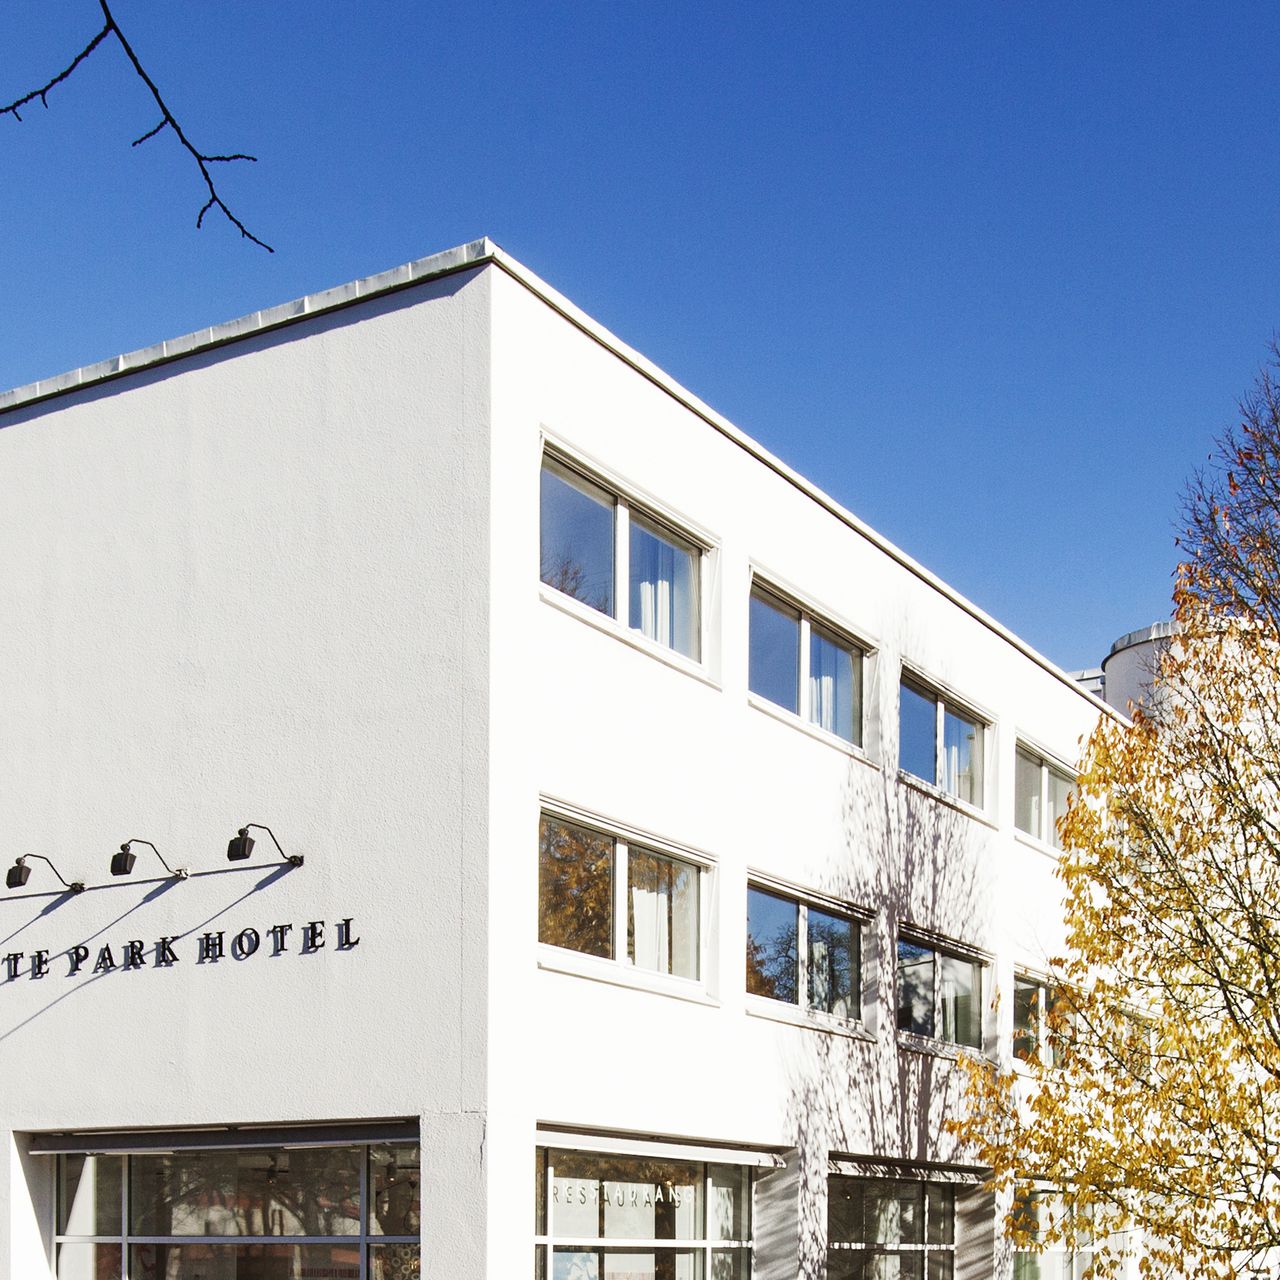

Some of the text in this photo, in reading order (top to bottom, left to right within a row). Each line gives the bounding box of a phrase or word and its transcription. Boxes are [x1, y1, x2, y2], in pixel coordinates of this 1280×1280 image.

[66, 936, 180, 976] PARK
[197, 917, 360, 963] HOTEL
[554, 1180, 691, 1208] RESTAURANG
